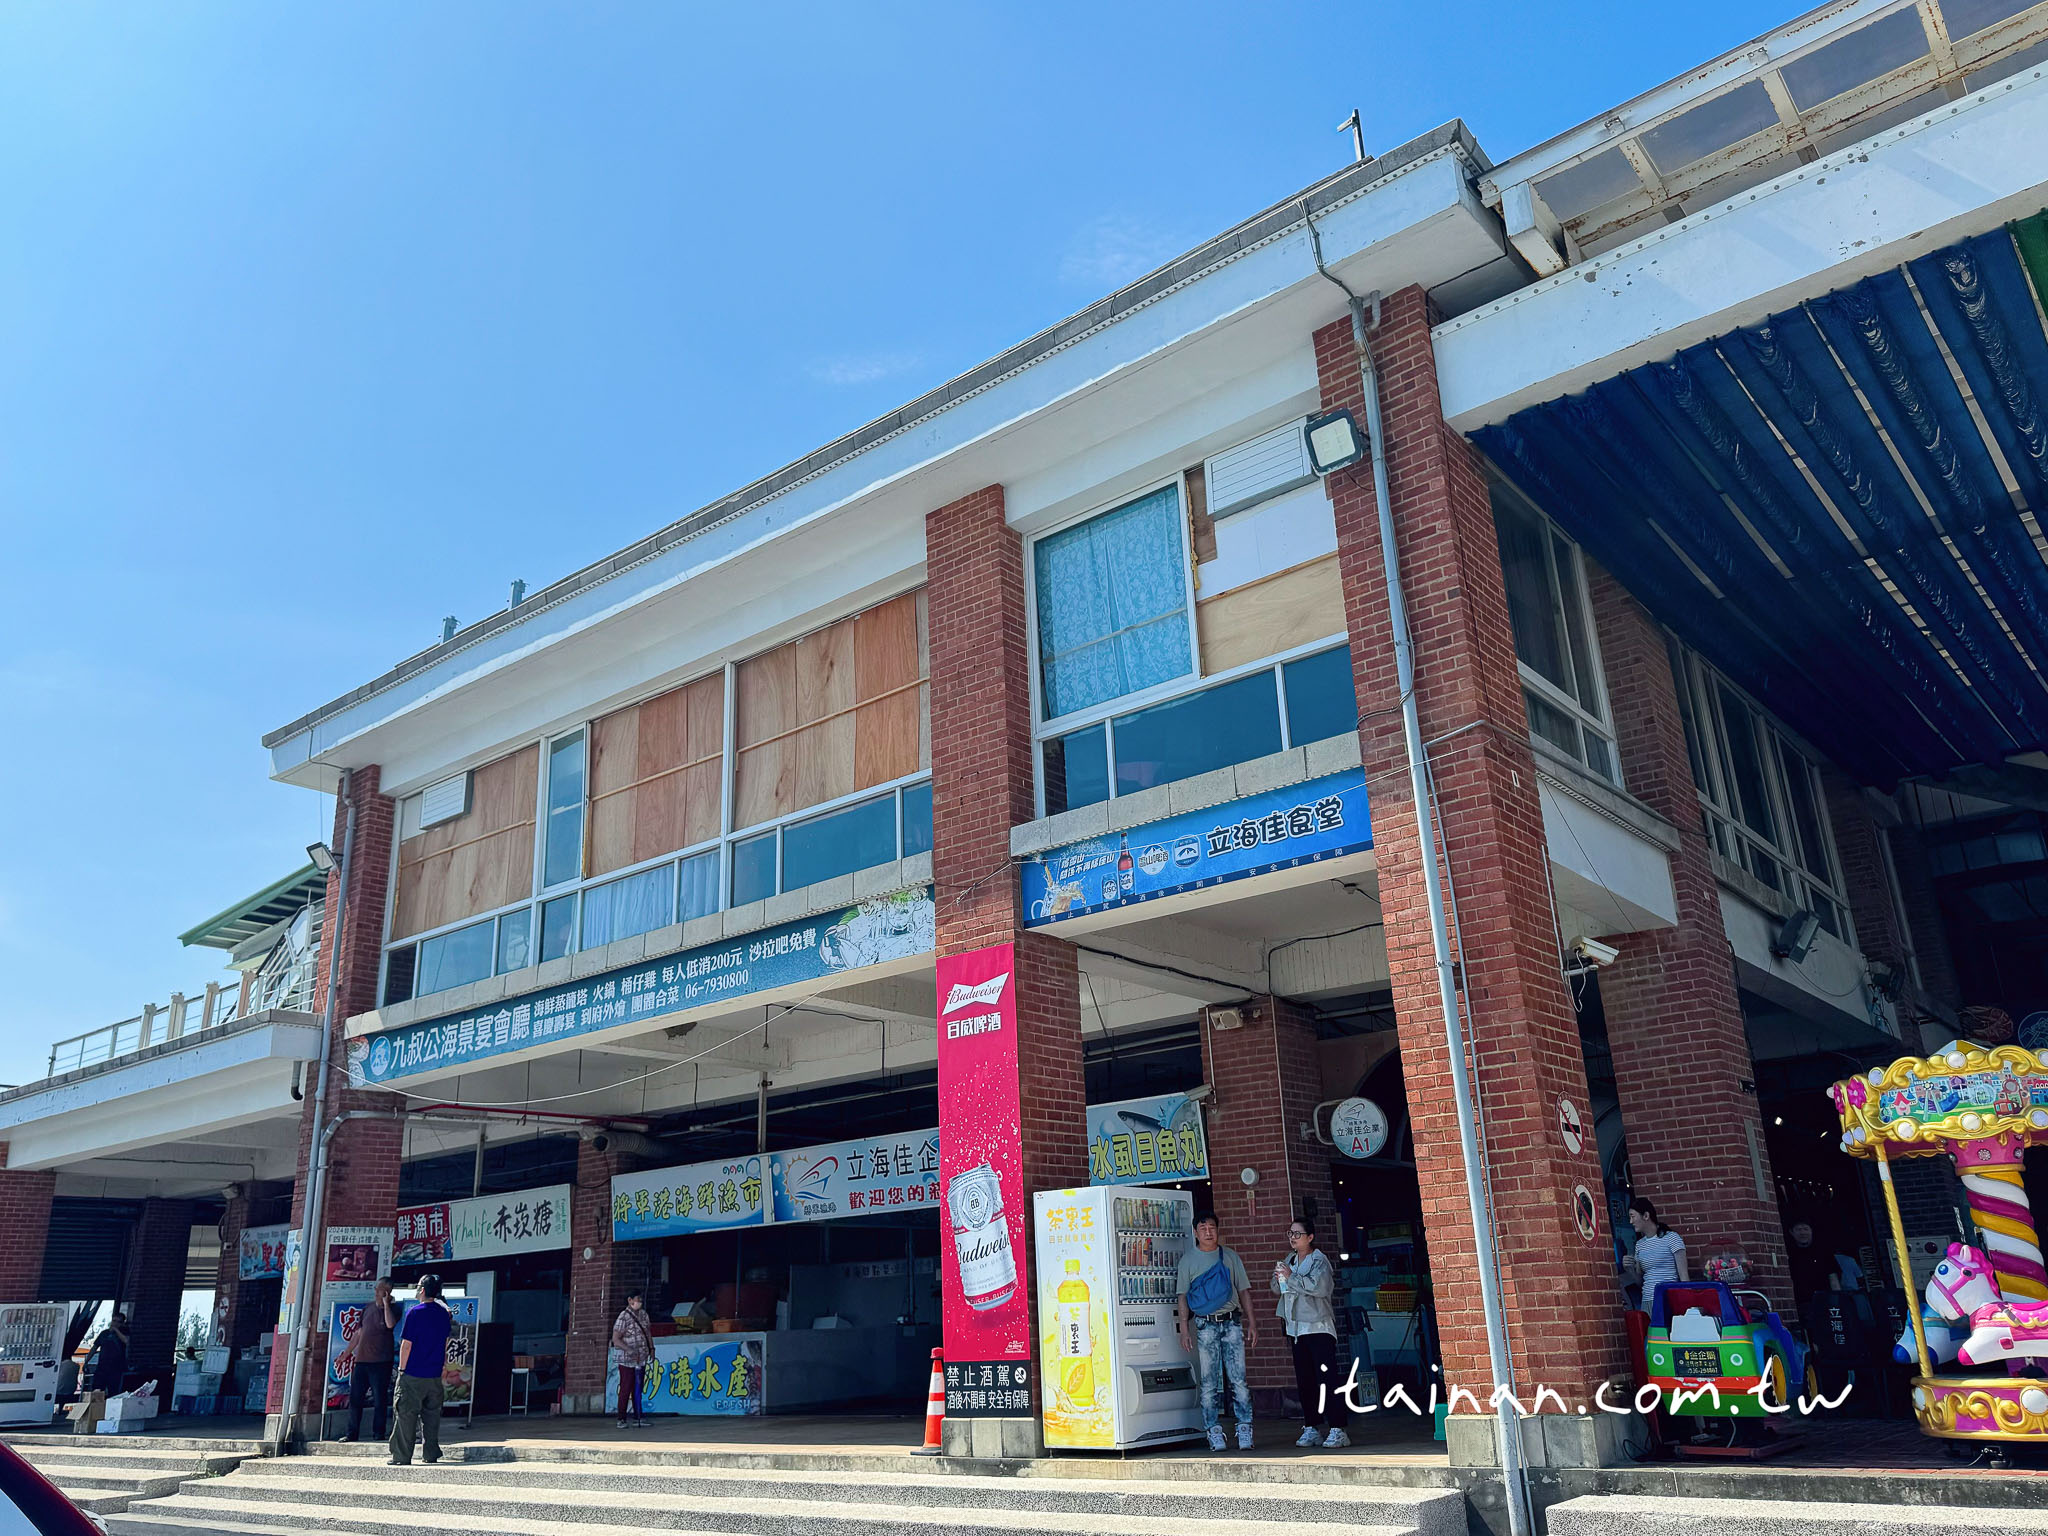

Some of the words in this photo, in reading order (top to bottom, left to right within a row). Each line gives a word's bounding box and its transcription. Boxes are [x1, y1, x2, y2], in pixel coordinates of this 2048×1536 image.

[1206, 795, 1344, 858] 立海佳食堂
[534, 989, 588, 1018] 海鮮蒸籠塔
[593, 982, 615, 1003] 火鍋
[621, 970, 656, 998] 桶仔雞
[662, 947, 743, 983] 每人低消200元
[749, 928, 817, 963] 沙拉吧免費
[947, 984, 1004, 1004] Budweiser
[532, 1012, 575, 1039] 喜慶壽宴
[581, 999, 624, 1025] 到府外燴
[631, 986, 679, 1014] 團體合菜
[685, 969, 749, 998] 06-7930800
[391, 1003, 531, 1070] 九叔公海景宴會廳
[947, 1012, 1001, 1040] 百威啤酒
[1336, 1124, 1380, 1136] 立海佳企業
[1352, 1136, 1370, 1153] A1
[846, 1139, 940, 1181] 立海佳企
[1090, 1125, 1205, 1180] 水虱目魚丸
[493, 1199, 554, 1243] 赤崁糖
[614, 1177, 762, 1224] 將軍港海鮮漁市
[617, 1354, 750, 1400] 沙溝水產
[946, 1365, 1010, 1388] 禁止酒駕
[716, 1400, 750, 1410] FRESH
[946, 1390, 987, 1410] 酒後不開車
[987, 1389, 1030, 1410] 安全有保障
